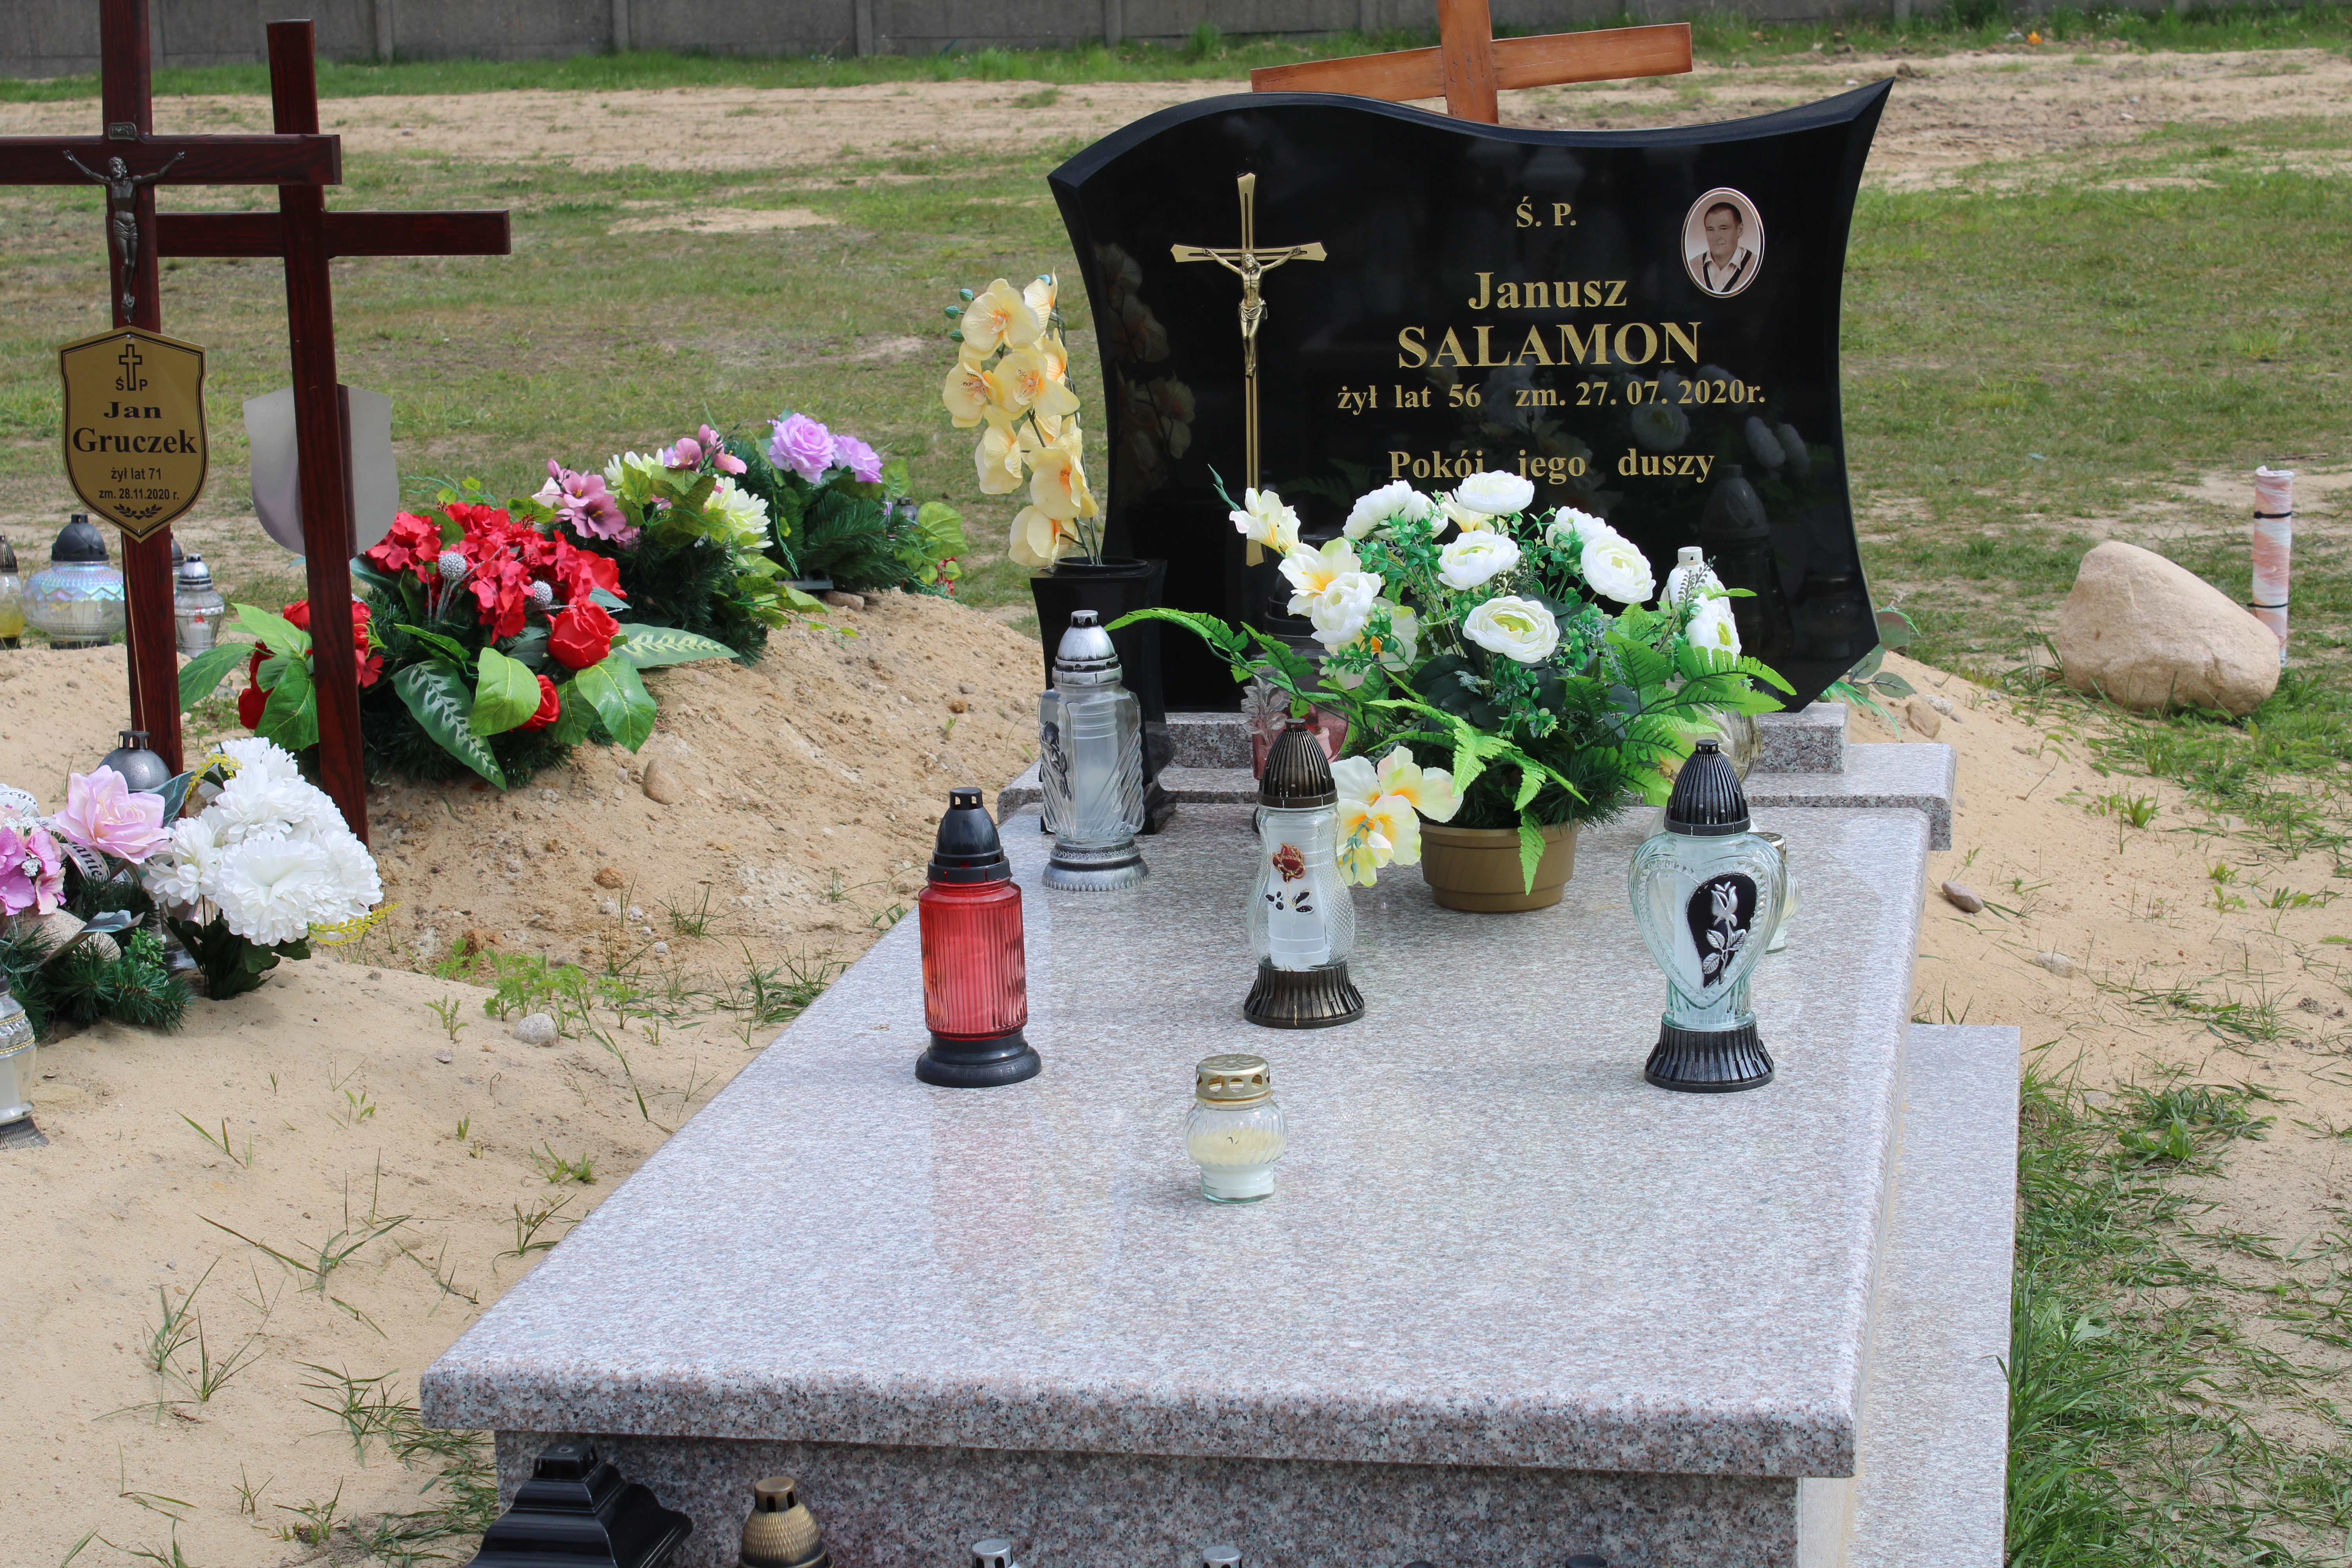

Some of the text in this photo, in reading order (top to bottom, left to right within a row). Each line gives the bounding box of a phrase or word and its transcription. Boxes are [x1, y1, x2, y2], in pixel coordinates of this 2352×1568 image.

[111, 125, 133, 135] INRI
[1517, 196, 1576, 227] Ś. P.
[1468, 272, 1627, 310] Janusz
[1399, 322, 1701, 368] SALAMON
[115, 376, 148, 391] Ś P
[1338, 379, 1766, 415] żył lat 56 zm. 27. 07. 2020r.
[103, 401, 163, 419] Jan
[73, 427, 198, 454] Gruczek
[111, 466, 161, 483] żył lat 71
[1388, 448, 1715, 485] Pokój jego duszy
[98, 488, 180, 500] zm. 28.11.2020 r.
